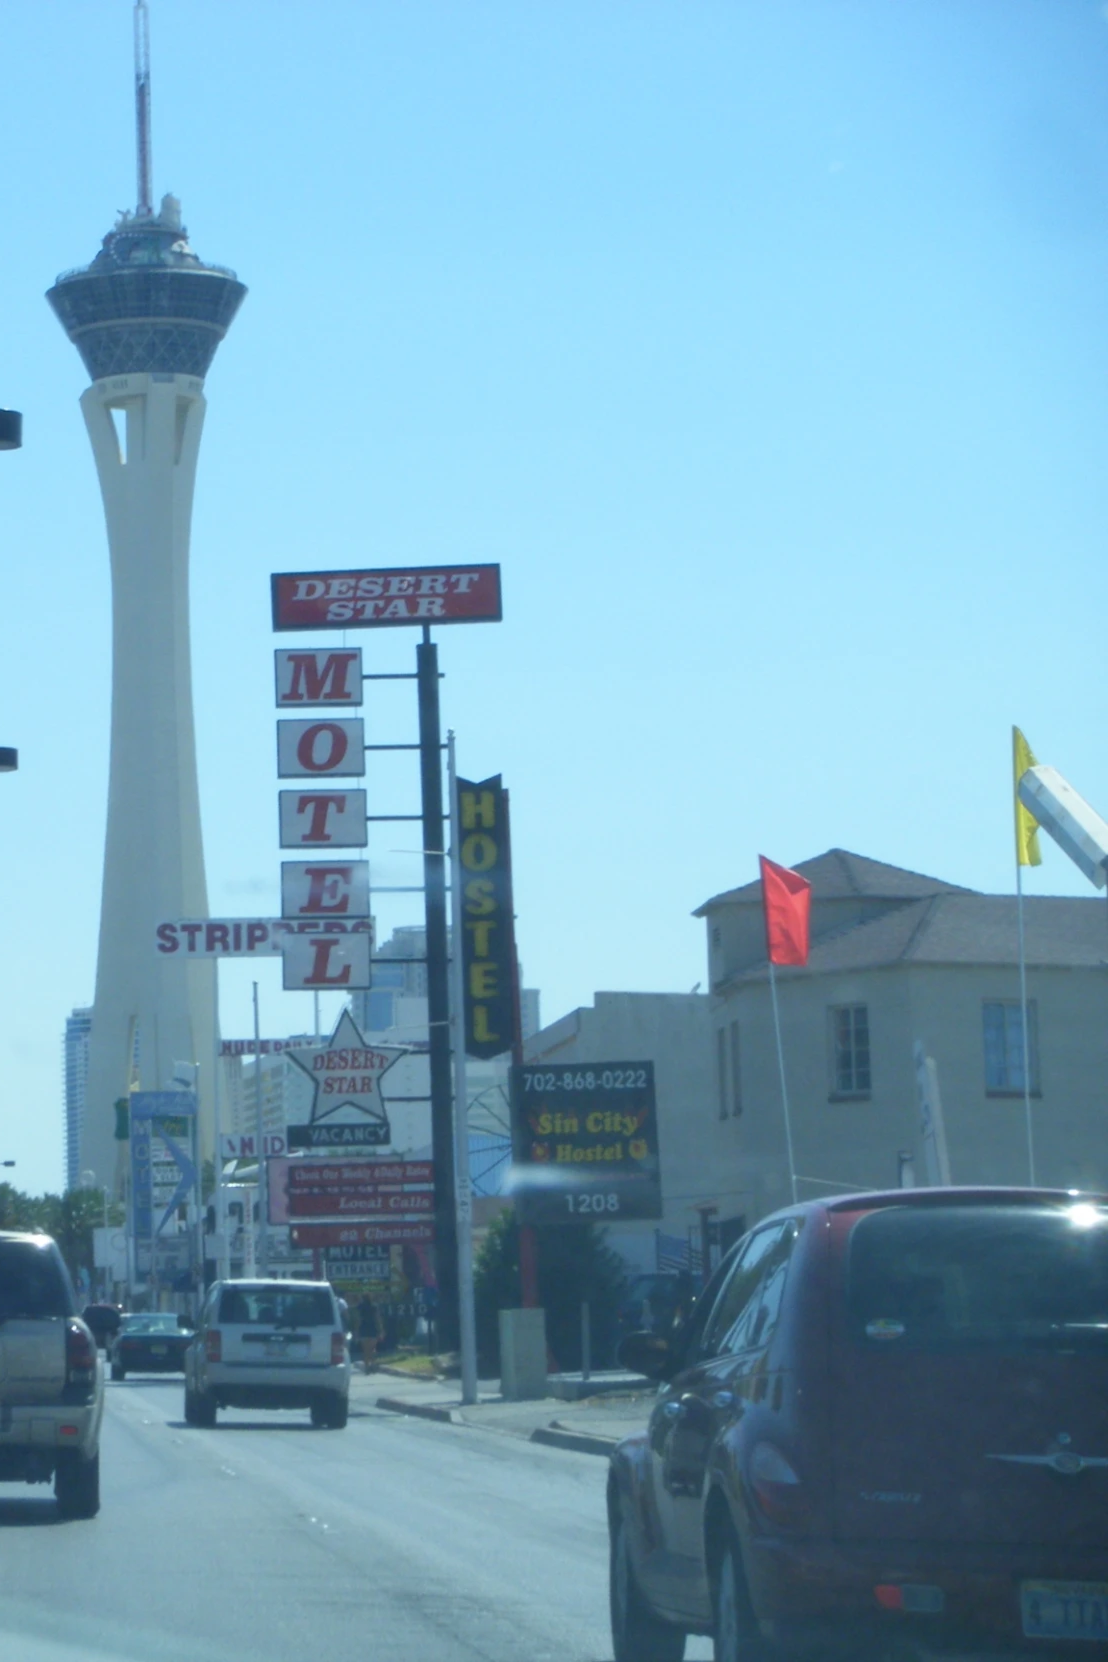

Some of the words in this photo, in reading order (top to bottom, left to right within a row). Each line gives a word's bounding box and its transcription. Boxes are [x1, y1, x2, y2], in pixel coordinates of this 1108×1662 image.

[293, 573, 479, 600] DESERT
[326, 597, 446, 621] STAR
[281, 653, 358, 984] MOTEL
[460, 791, 499, 1043] HOSTEL
[156, 920, 374, 953] STRIPP
[312, 1048, 389, 1071] DESERT
[322, 1076, 372, 1094] STAR
[523, 1070, 647, 1092] 702-868-0222
[309, 1126, 389, 1142] VACANCY
[538, 1112, 579, 1135] Sin
[585, 1111, 639, 1136] City
[556, 1142, 623, 1162] Hostel
[339, 1197, 382, 1209] Local
[389, 1196, 430, 1208] Calls
[565, 1194, 619, 1213] 1208
